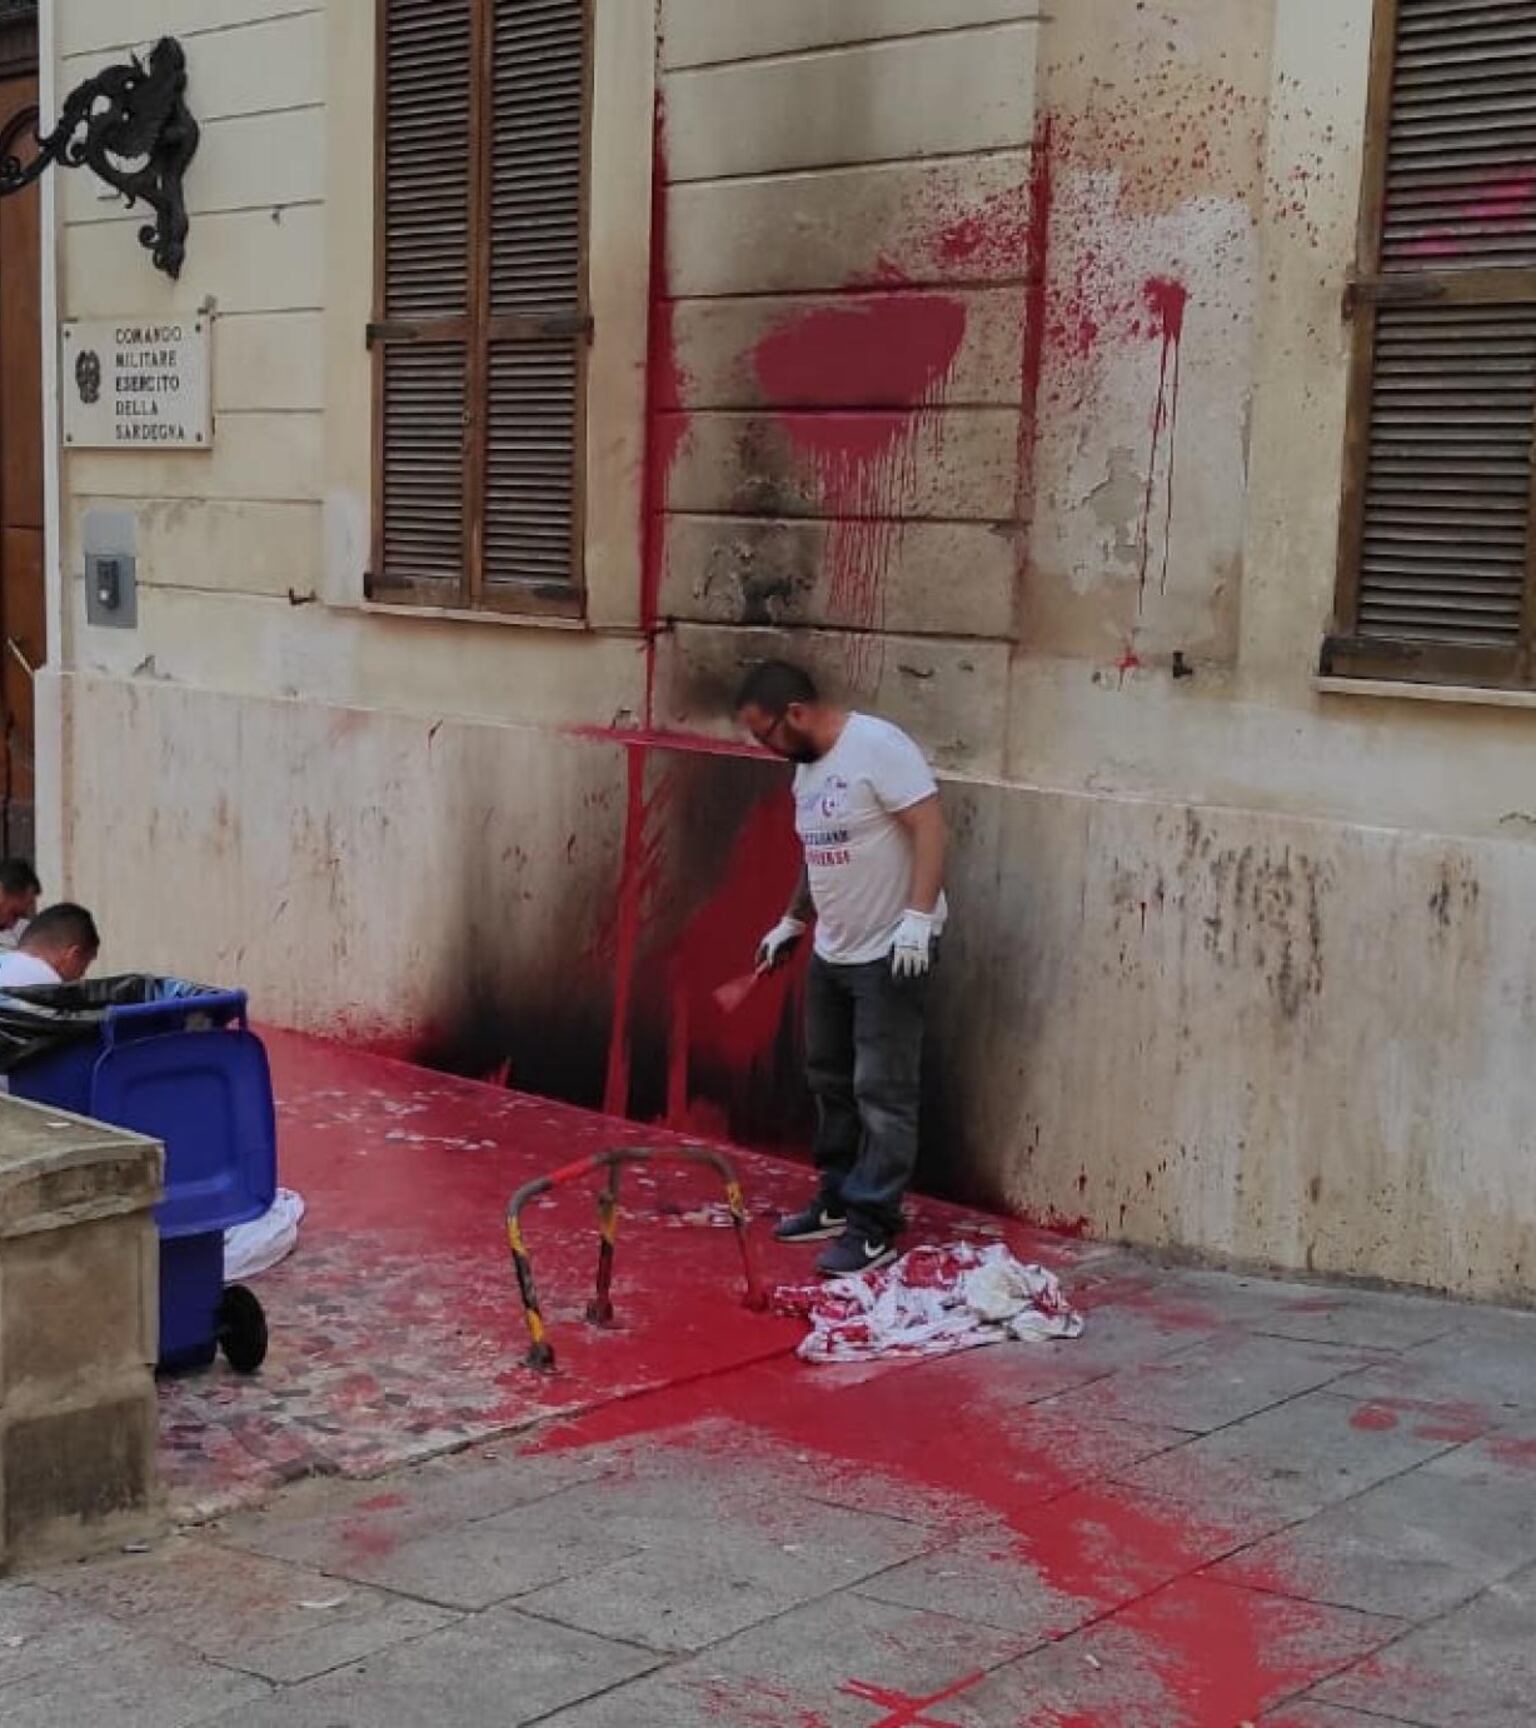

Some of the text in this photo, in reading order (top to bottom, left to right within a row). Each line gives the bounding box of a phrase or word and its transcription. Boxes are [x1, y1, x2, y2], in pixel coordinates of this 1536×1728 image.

[116, 326, 182, 344] COMANDO
[115, 350, 177, 368] MILITARE
[115, 375, 180, 392] ESERCITO
[115, 400, 158, 416] DELLA
[115, 423, 184, 440] SARDEGNA
